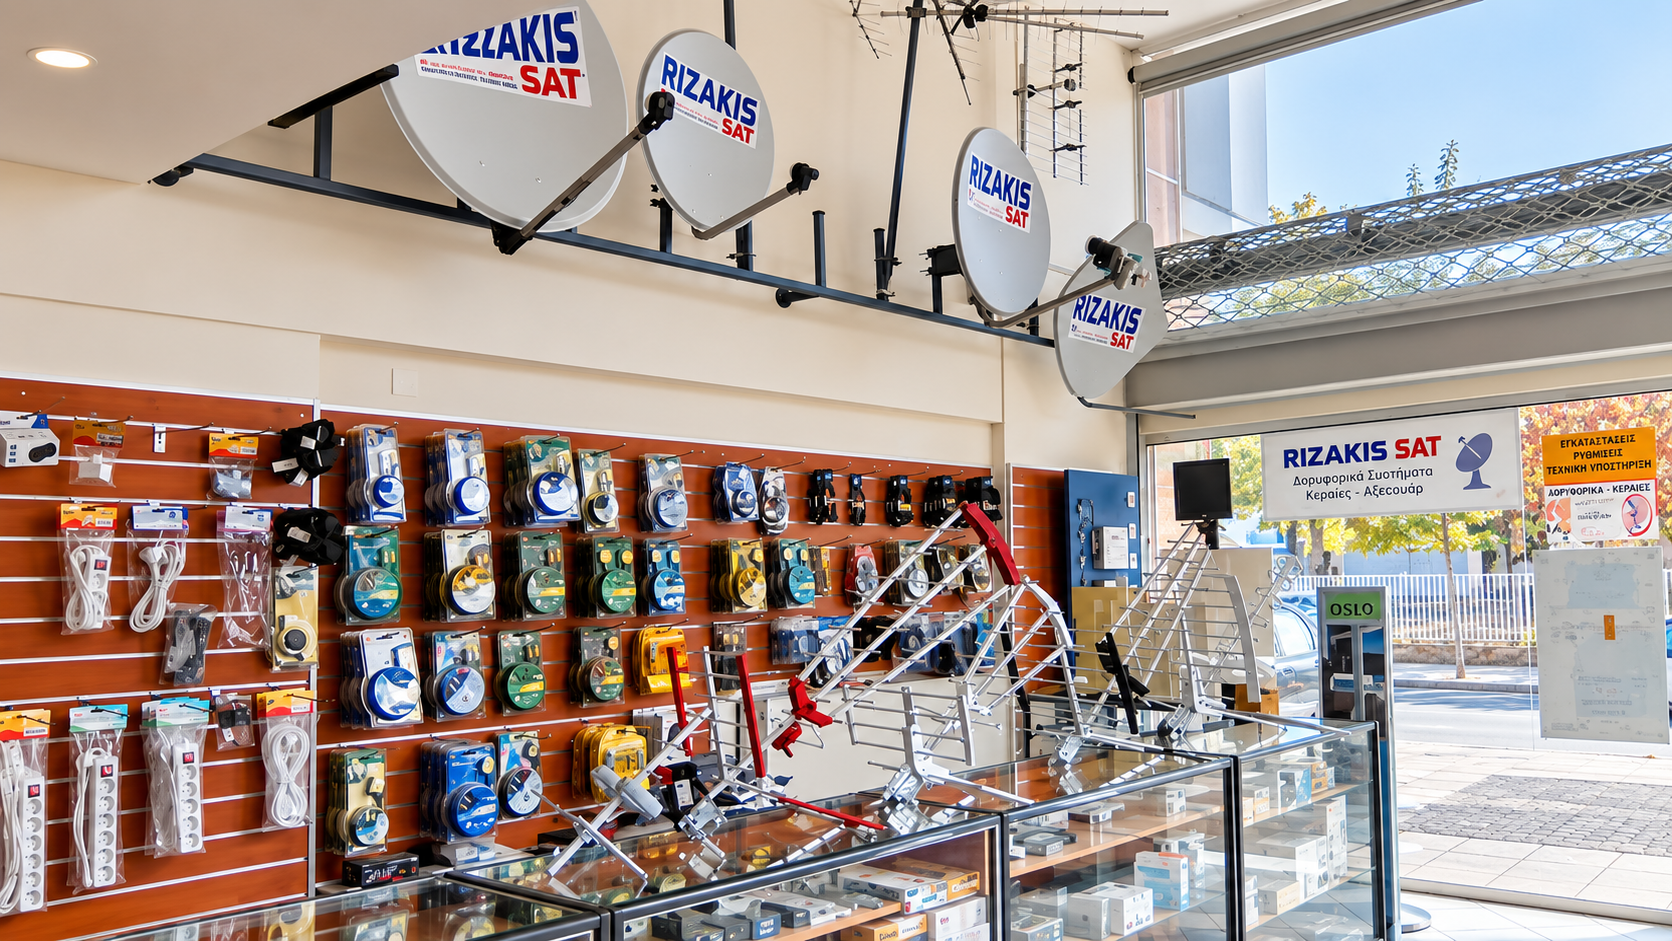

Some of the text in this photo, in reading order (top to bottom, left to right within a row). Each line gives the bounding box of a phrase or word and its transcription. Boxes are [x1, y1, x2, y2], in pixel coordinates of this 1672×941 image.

[520, 65, 582, 99] SAT
[661, 54, 758, 127] RIZAKIS
[722, 117, 755, 144] SAT
[969, 154, 1032, 211] RIZAKIS
[1005, 205, 1029, 228] SAT
[1072, 295, 1142, 335] RIZAKIS
[1110, 332, 1134, 350] SAT
[1283, 435, 1442, 468] RIZAKIS SAT
[1293, 470, 1364, 487] Δορυφορικά
[1546, 464, 1588, 476] ΤΕΧΝΙΚΗ
[1306, 487, 1352, 502] Κεραίες
[1330, 602, 1374, 616] OSLO
